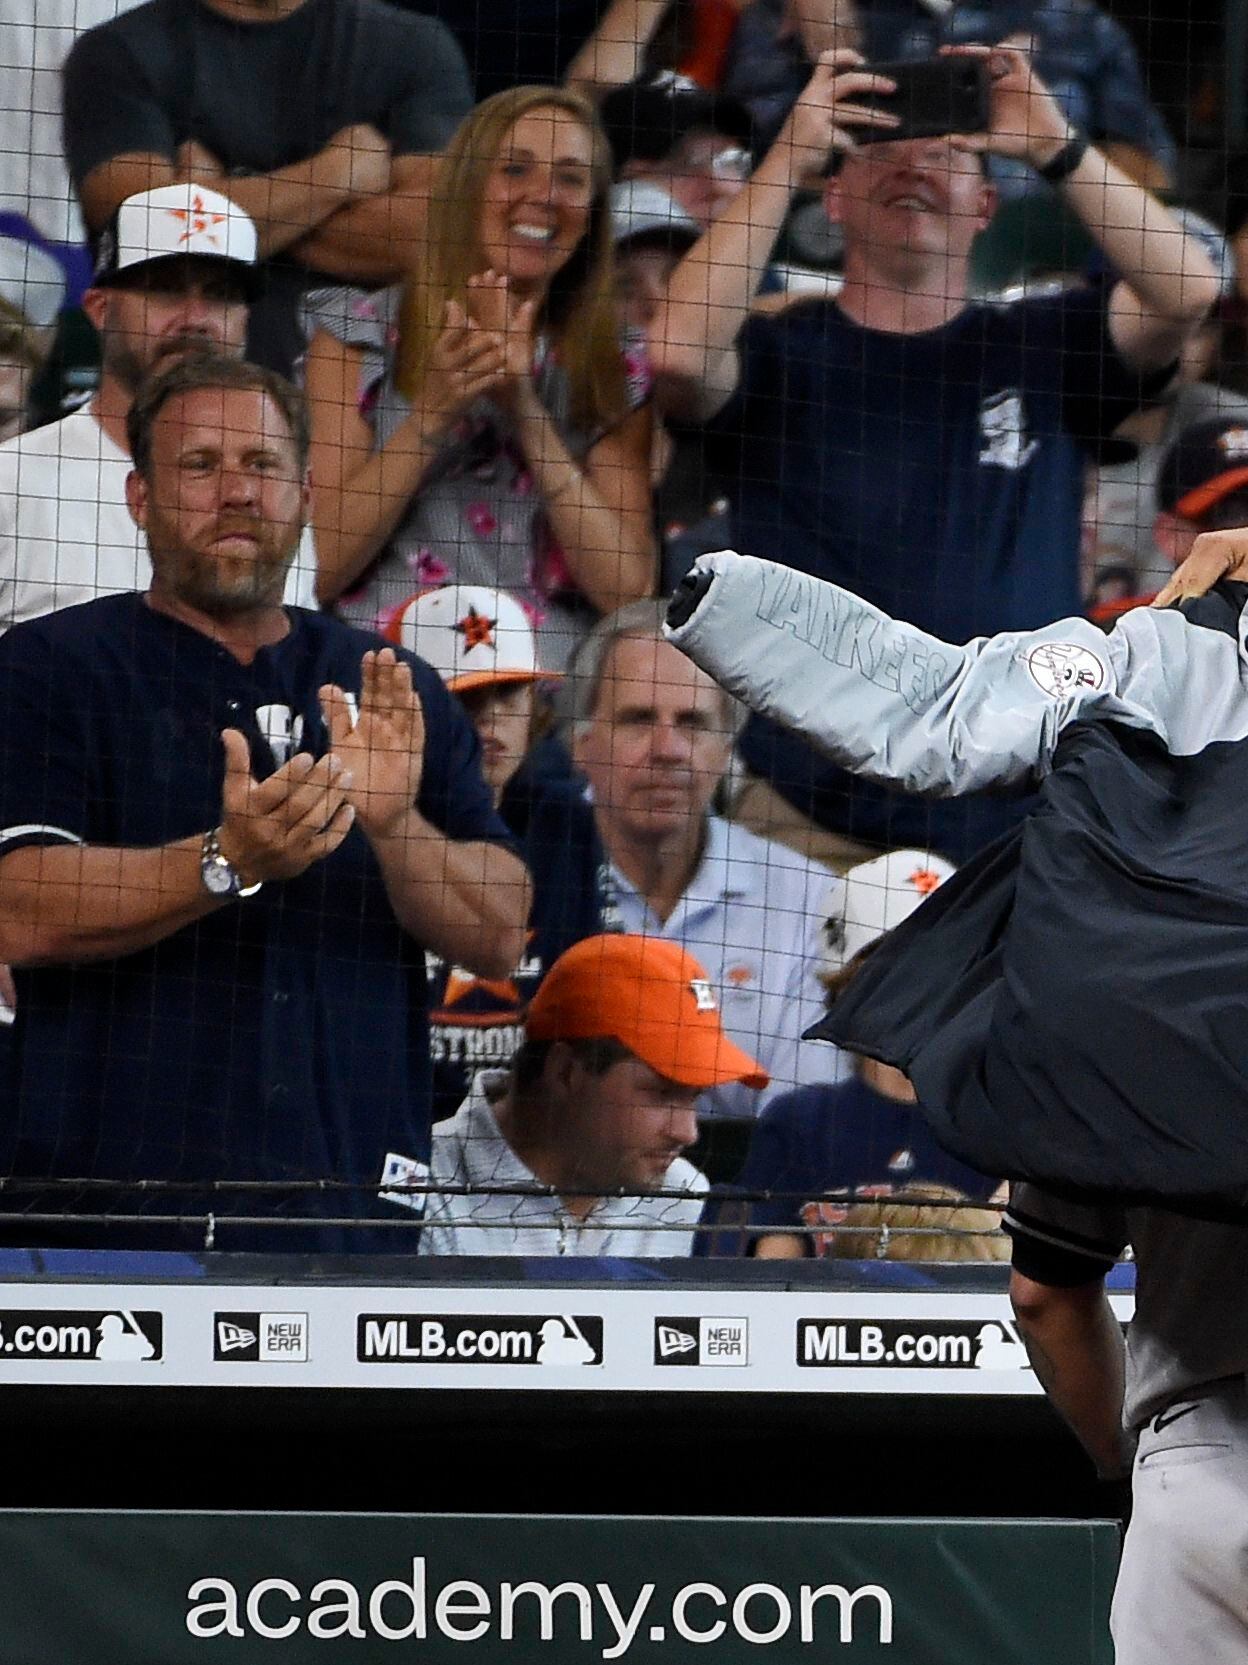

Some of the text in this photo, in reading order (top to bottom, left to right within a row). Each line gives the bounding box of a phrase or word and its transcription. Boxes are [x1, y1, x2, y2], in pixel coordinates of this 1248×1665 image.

[267, 1323, 302, 1337] NEW
[707, 1327, 742, 1342] NEW
[267, 1337, 302, 1352] ERA
[364, 1320, 533, 1358] MLB.com
[804, 1325, 971, 1362] MLB.com
[707, 1341, 741, 1356] ERA
[186, 1556, 893, 1659] academy.com
